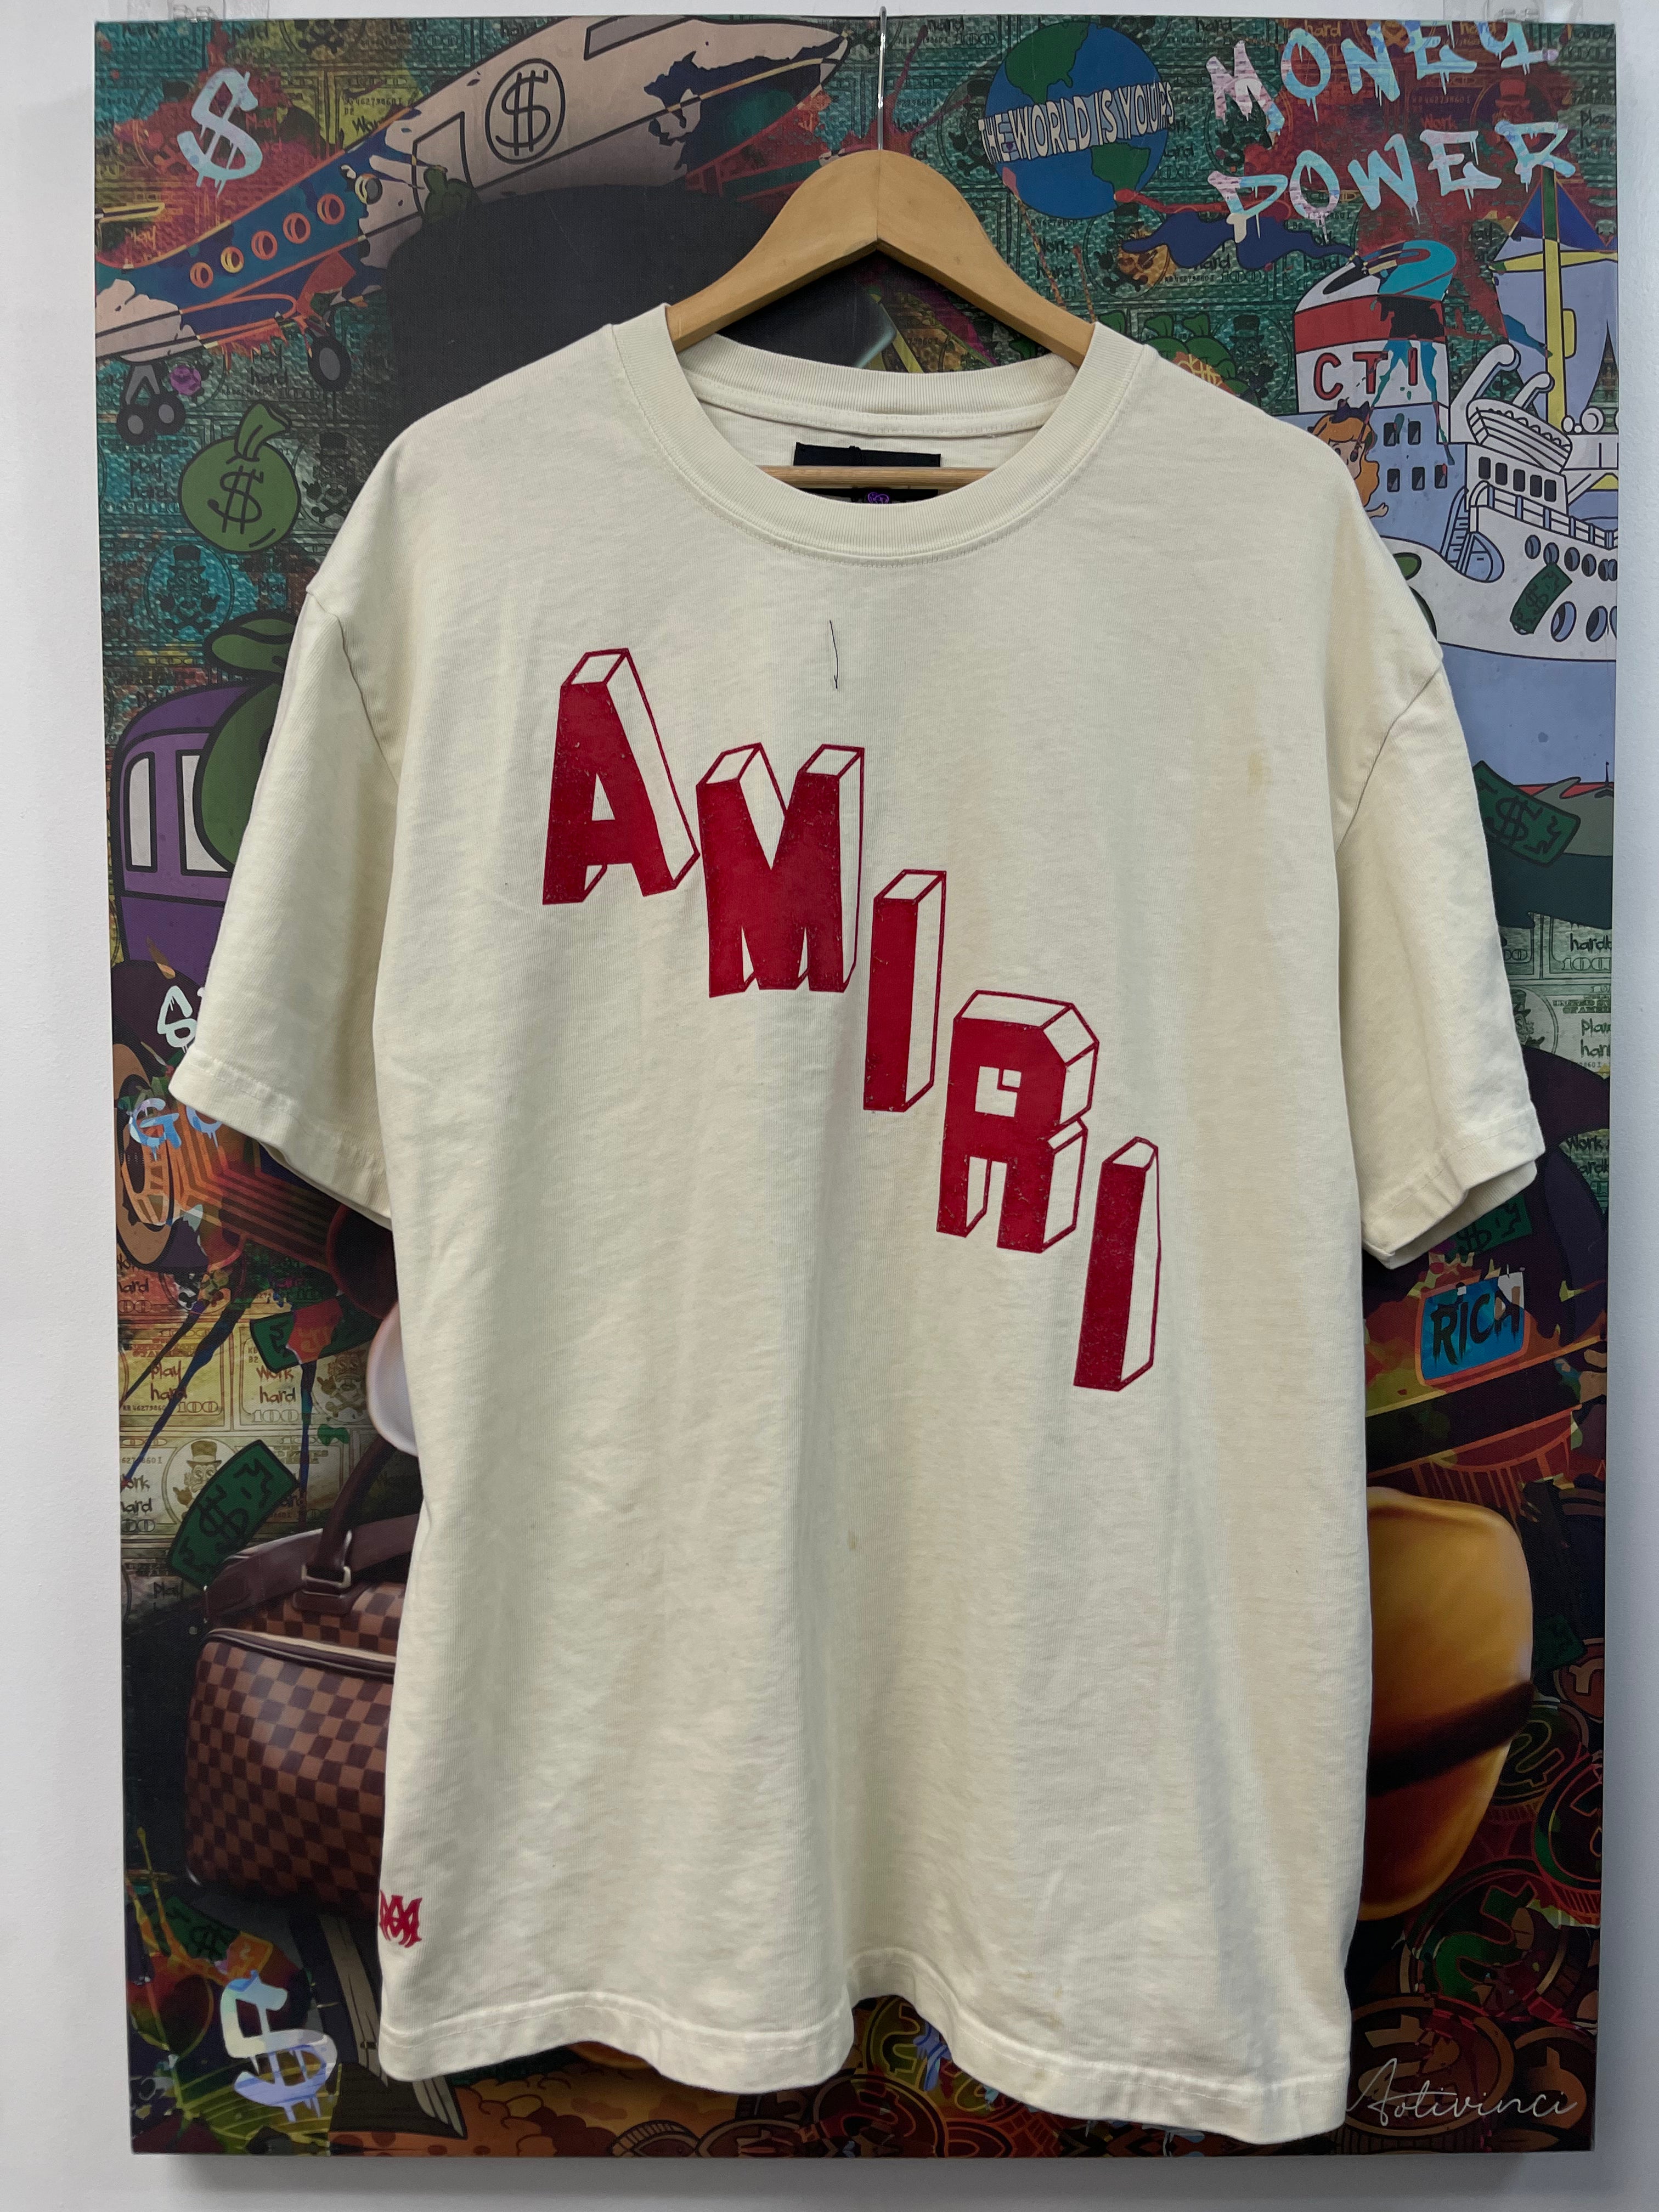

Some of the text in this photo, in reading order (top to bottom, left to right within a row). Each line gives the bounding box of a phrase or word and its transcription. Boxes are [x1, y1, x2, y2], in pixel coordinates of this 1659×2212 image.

[978, 112, 1015, 163] THE
[1008, 95, 1092, 161] WORLD
[1093, 88, 1119, 146] IS
[1118, 82, 1175, 140] YOURS
[1206, 20, 1559, 148] MONEY
[1207, 119, 1576, 244] POWER
[1313, 347, 1418, 401] CTI
[543, 648, 1161, 1392] AMIRI
[259, 1386, 296, 1403] hard
